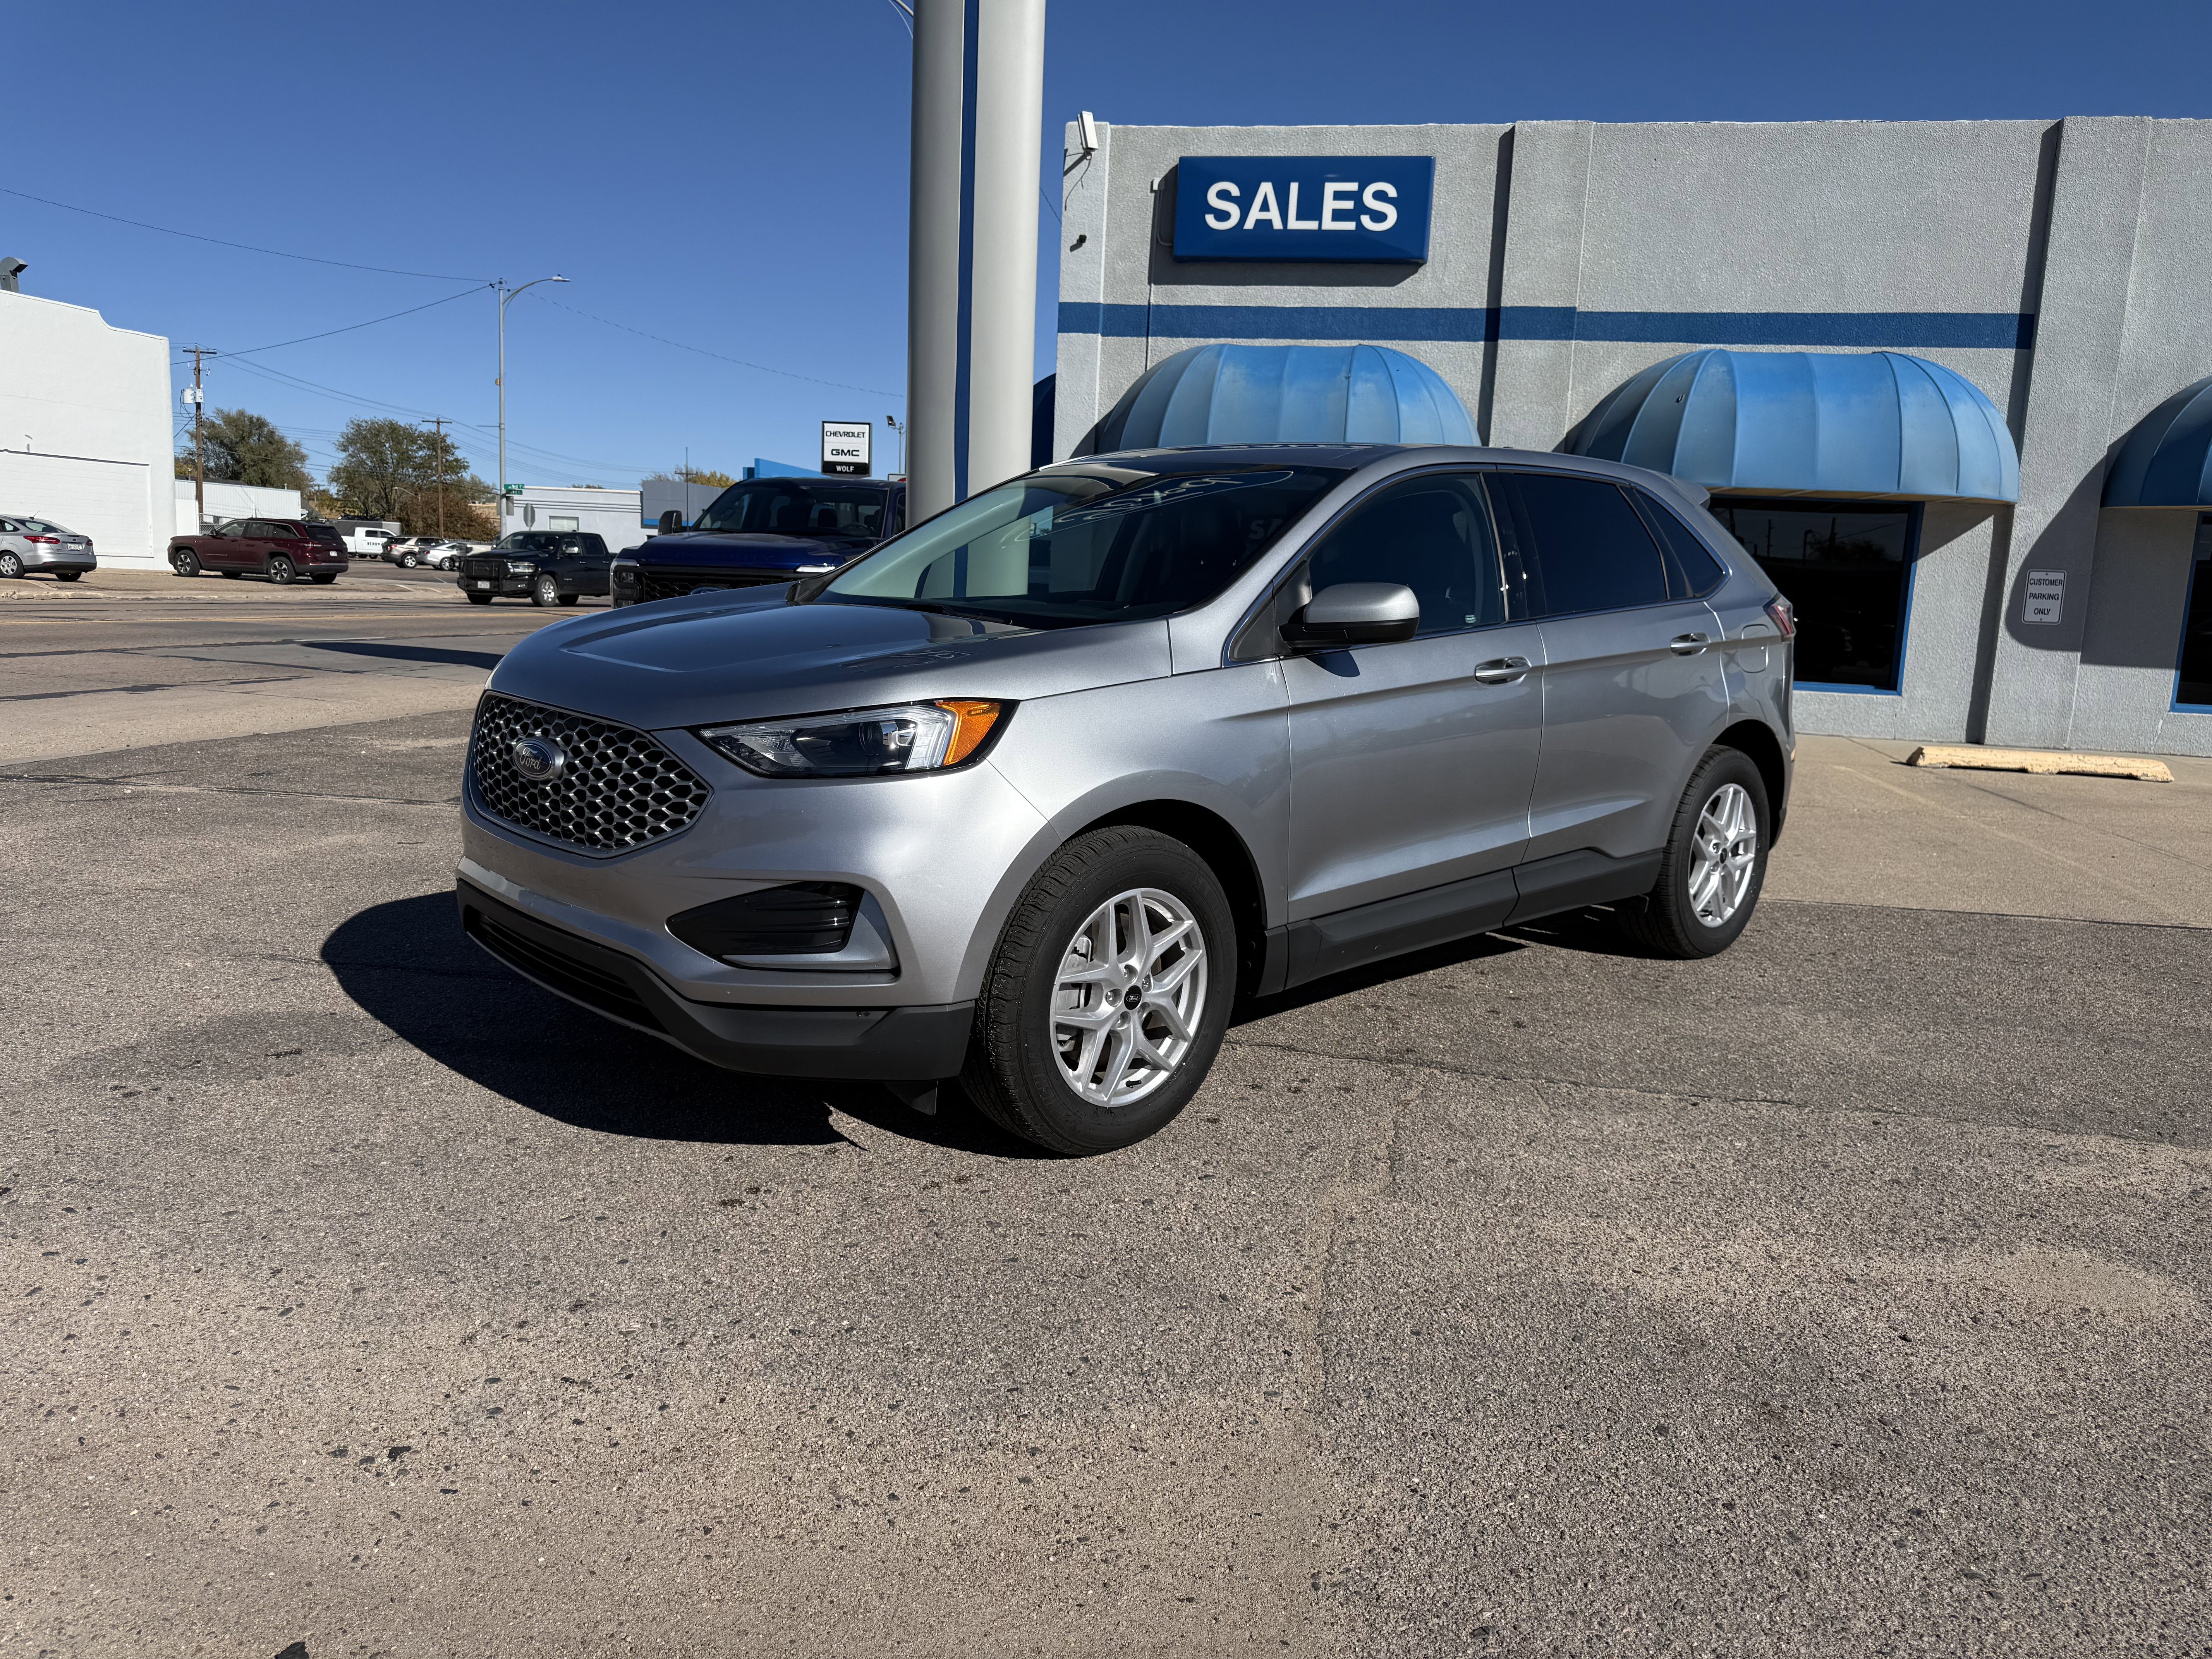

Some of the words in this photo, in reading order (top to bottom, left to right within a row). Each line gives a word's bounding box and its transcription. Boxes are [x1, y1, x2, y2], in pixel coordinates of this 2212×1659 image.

[1204, 181, 1398, 232] SALES
[2029, 578, 2063, 586] CUSTOMER
[2029, 592, 2059, 601] PARKING
[520, 747, 542, 770] Ford
